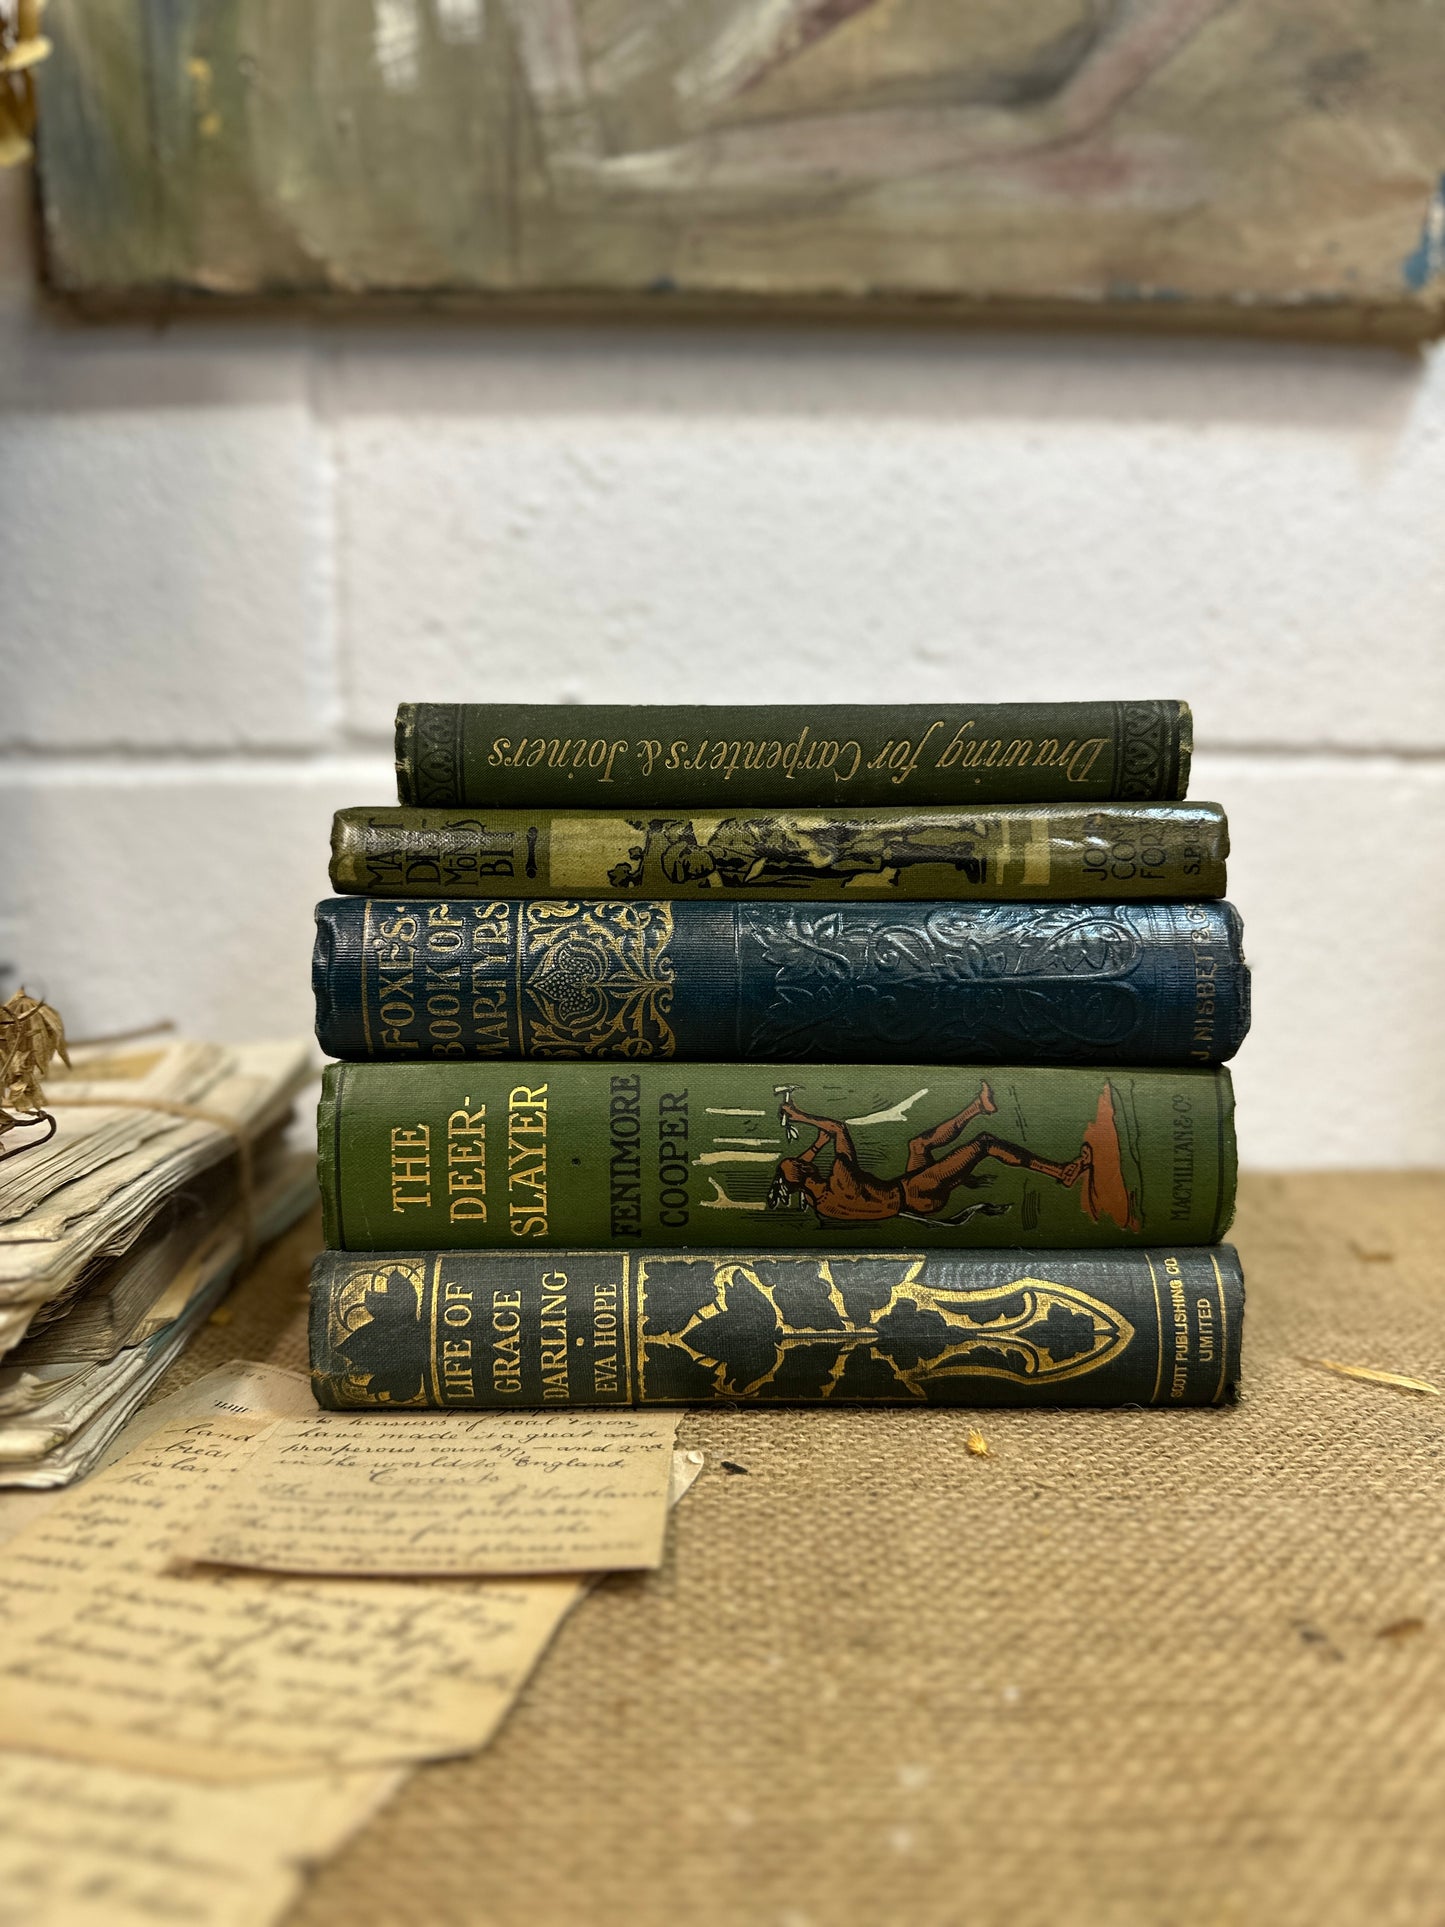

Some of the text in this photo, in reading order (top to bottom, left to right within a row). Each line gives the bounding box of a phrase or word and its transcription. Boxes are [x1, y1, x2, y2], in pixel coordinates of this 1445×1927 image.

[488, 720, 1111, 784] Drawing for Carpenters & Joiners
[405, 818, 441, 884] DE-
[372, 916, 419, 1049] FOXE'S
[426, 903, 465, 1057] BOOK OF
[472, 900, 510, 1056] MARTYRS
[391, 1123, 432, 1213] THE
[447, 1095, 488, 1224] DEER-
[508, 1083, 549, 1238] SLAYER
[609, 1074, 642, 1239] FENIMORE
[658, 1087, 690, 1228] COOPER
[443, 1281, 475, 1399] LIFE OF
[492, 1289, 522, 1393] GRACE
[540, 1269, 569, 1400] DARLING
[594, 1283, 618, 1393] EVA HOPE
[1169, 1279, 1188, 1361] PUBLISHING
[1197, 1297, 1213, 1362] LIMITED
[458, 1415, 489, 1432] of
[1170, 1364, 1187, 1398] SCOTT
[281, 1443, 416, 1456] prosperous
[556, 1443, 611, 1453] and
[288, 1427, 366, 1439] have
[377, 1430, 459, 1440] made
[518, 1430, 594, 1444] great
[604, 1430, 665, 1439] and
